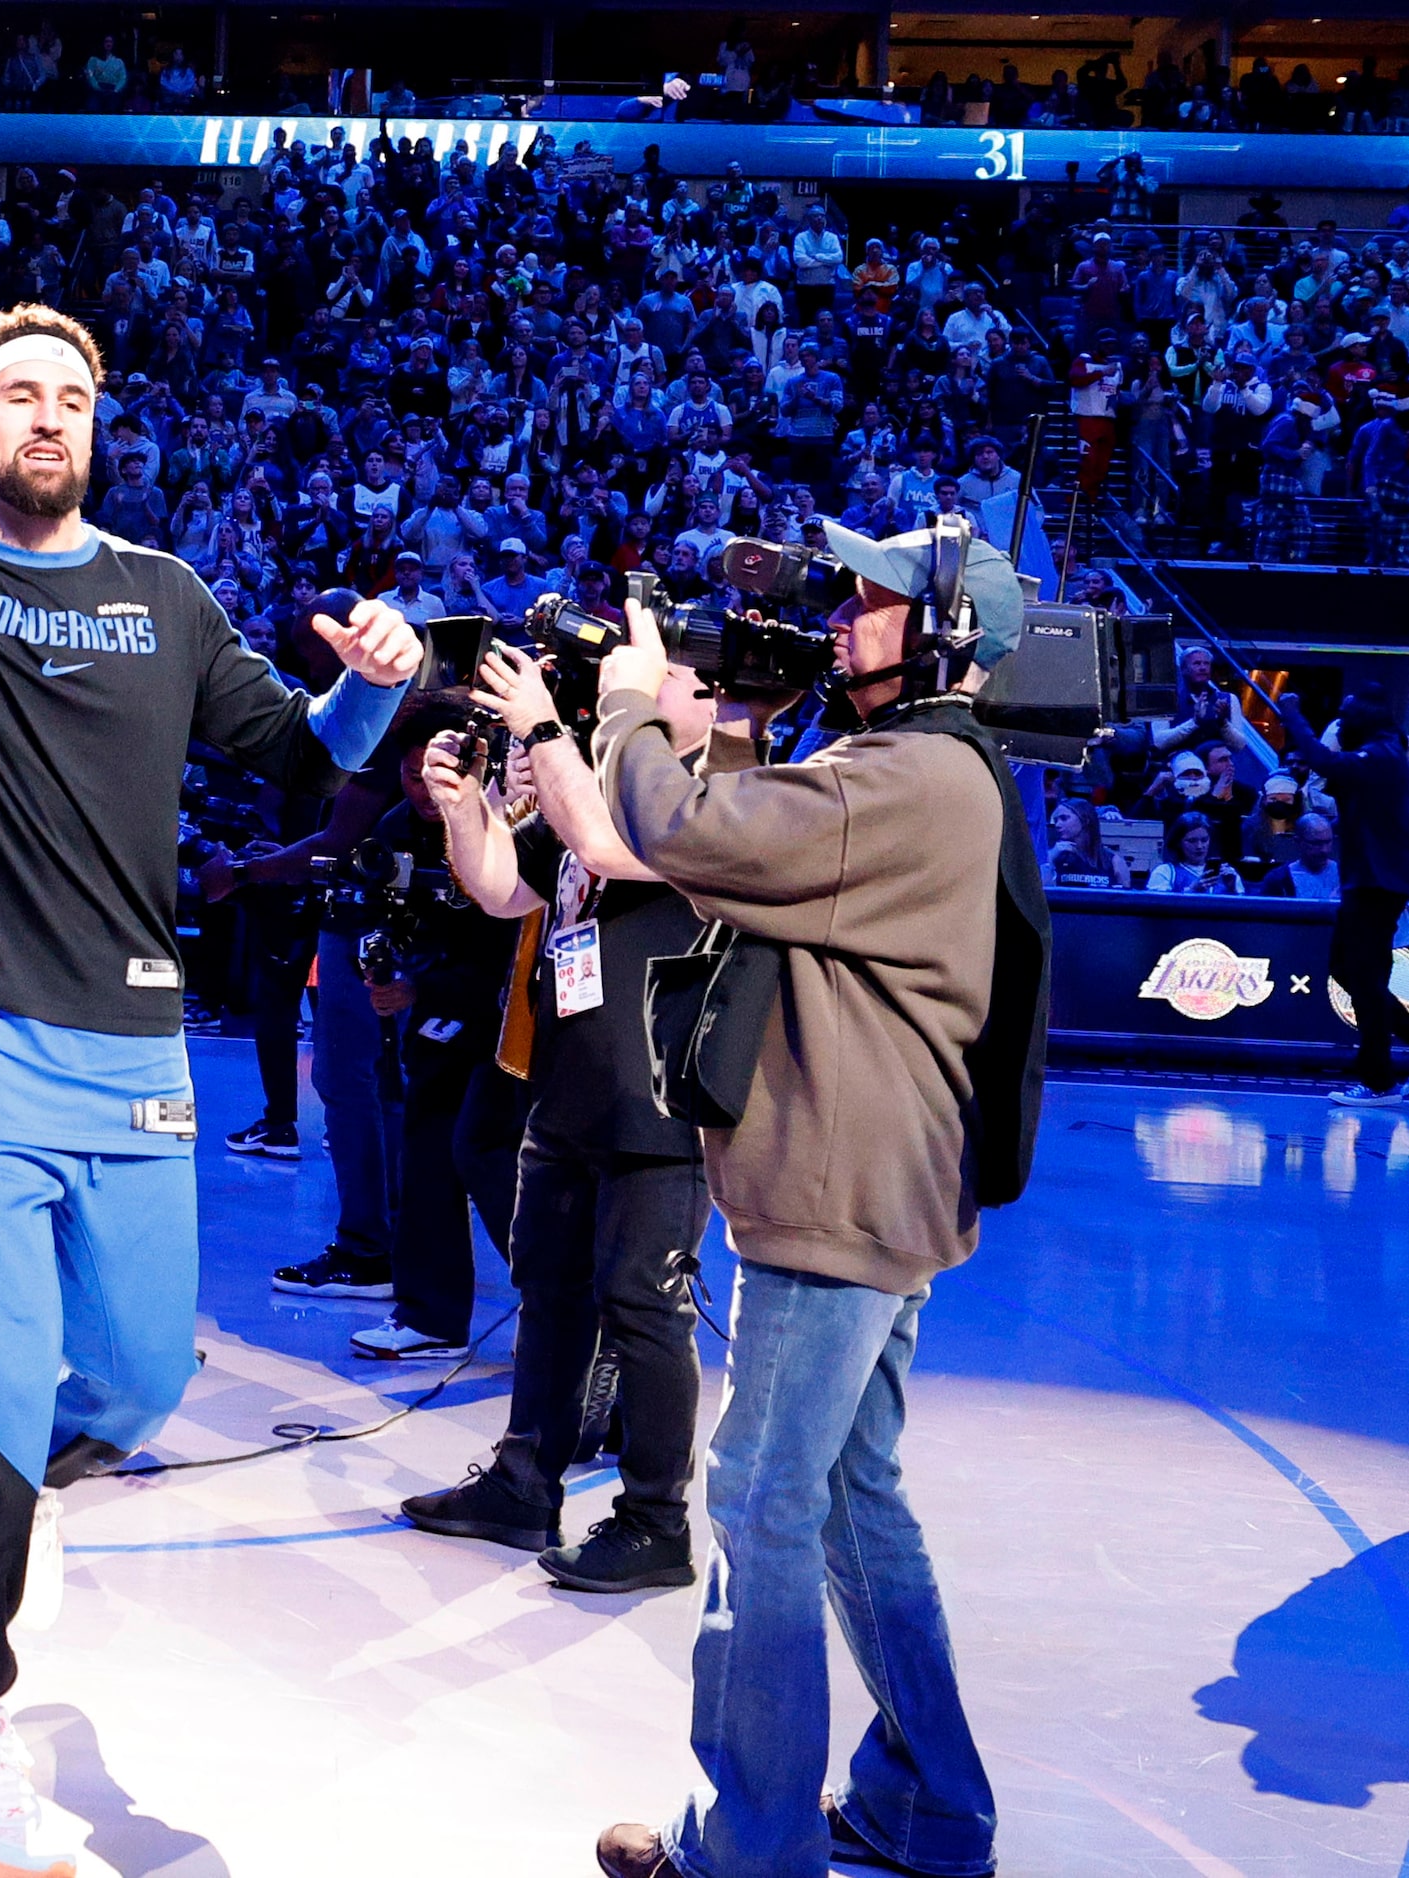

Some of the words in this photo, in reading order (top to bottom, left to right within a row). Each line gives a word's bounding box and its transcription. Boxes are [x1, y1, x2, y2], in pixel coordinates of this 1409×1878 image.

[975, 130, 1028, 181] 31
[797, 181, 819, 195] EXIT
[97, 602, 150, 617] shiftkey
[1034, 625, 1074, 637] INCAM-G
[1153, 958, 1259, 1000] LAKERS
